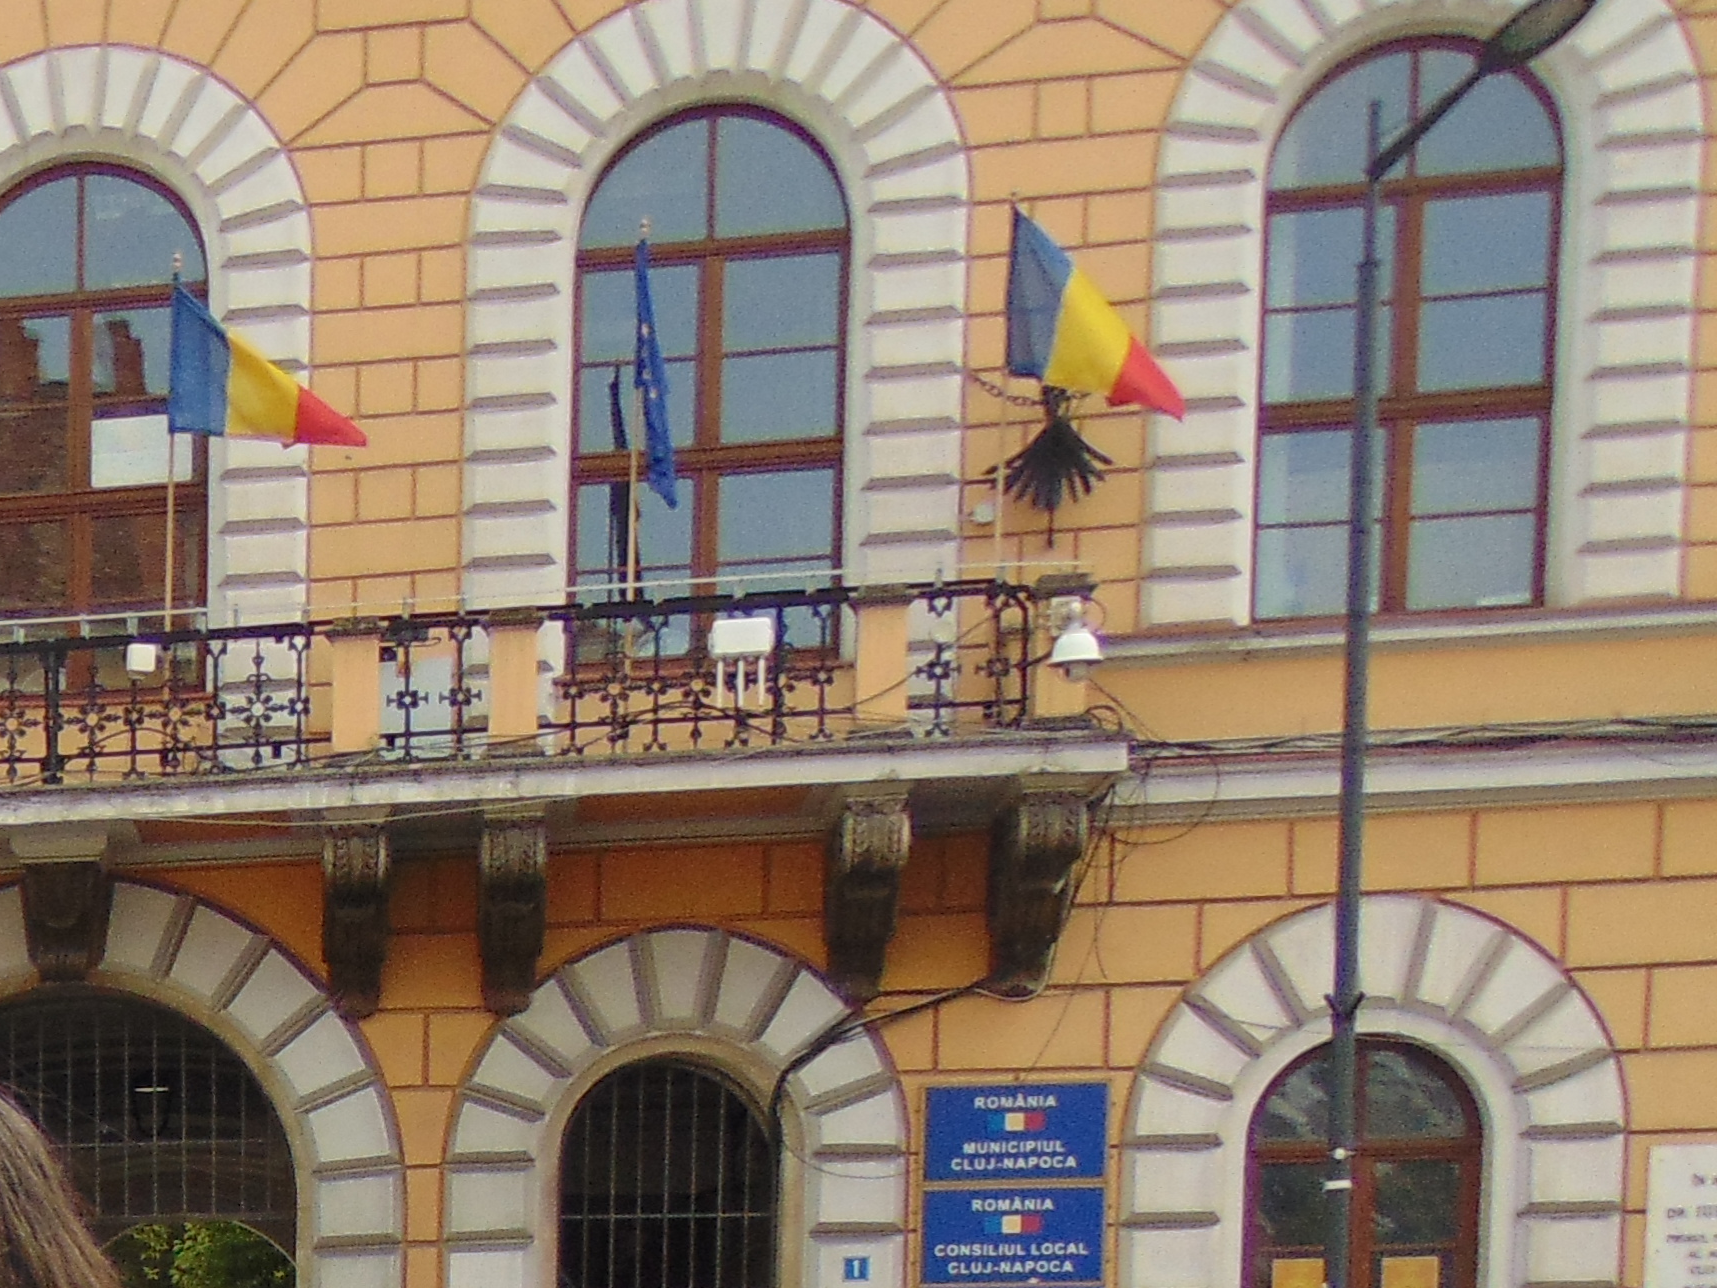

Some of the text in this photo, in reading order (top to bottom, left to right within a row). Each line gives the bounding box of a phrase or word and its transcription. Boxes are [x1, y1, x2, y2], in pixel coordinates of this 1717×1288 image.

[973, 1093, 1058, 1109] ROMÂNIA
[963, 1140, 1066, 1154] MUNICIPIUL
[950, 1156, 1078, 1171] CLUJ-NAPOCA
[970, 1196, 1055, 1212] ROMÂNIA
[933, 1242, 1090, 1257] CONSILIUL LOCAL
[852, 1259, 860, 1278] 1
[947, 1260, 1074, 1275] CLUJ-NAPOCA
